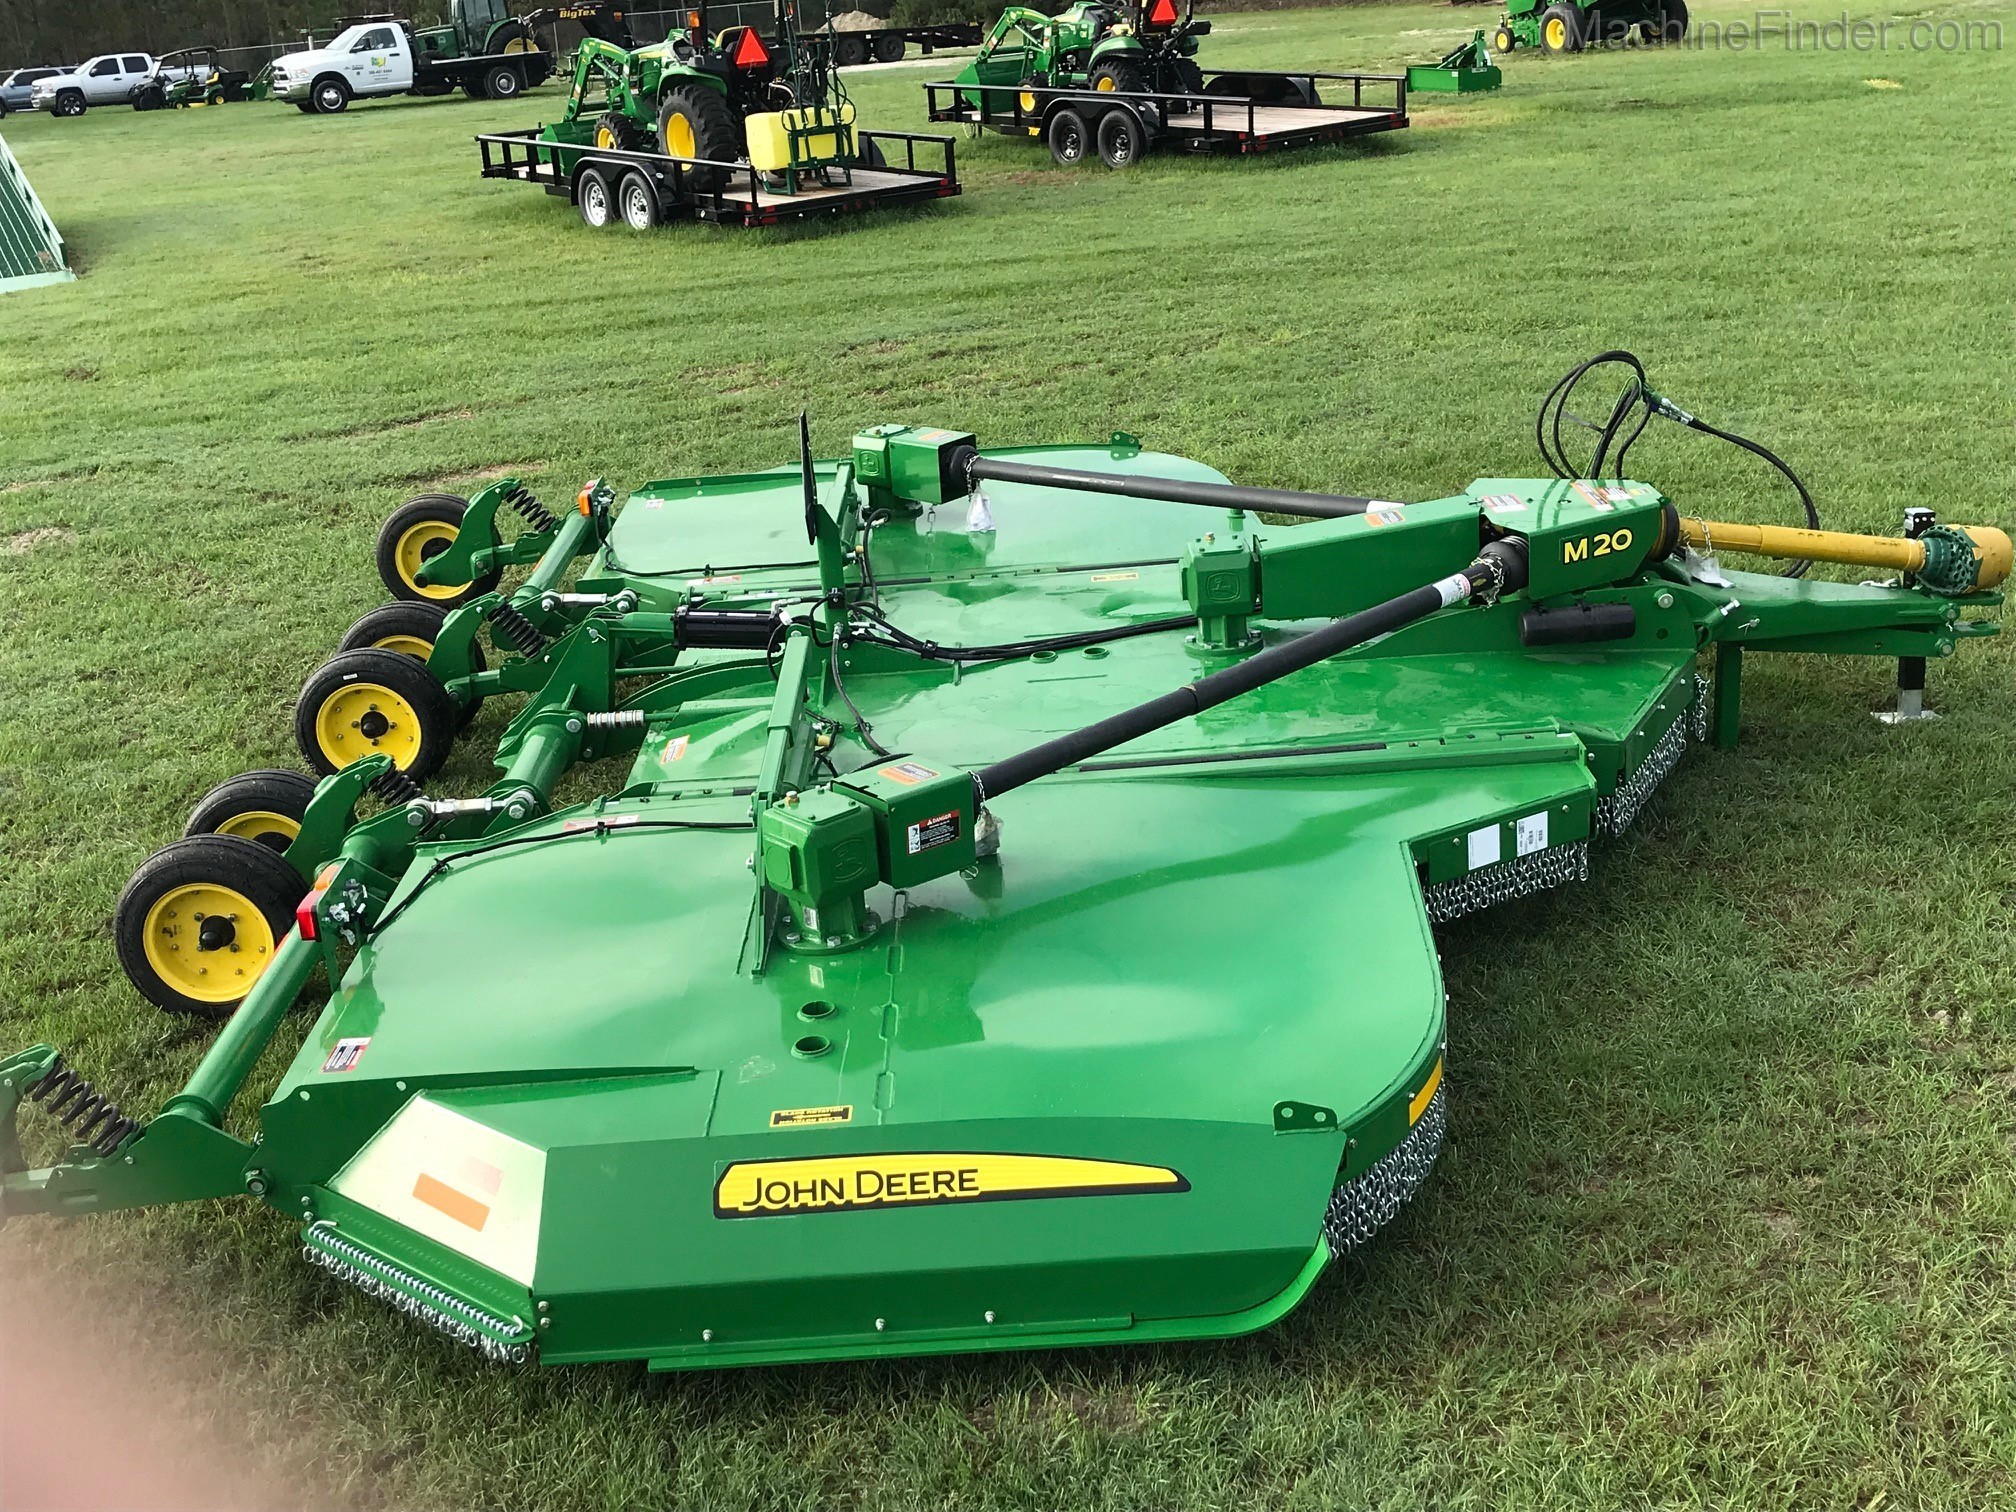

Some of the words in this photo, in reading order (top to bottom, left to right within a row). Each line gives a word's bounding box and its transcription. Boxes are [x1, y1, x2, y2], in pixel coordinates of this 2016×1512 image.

[560, 9, 596, 19] BigTex
[1564, 537, 1588, 564] M
[1593, 528, 1633, 557] 20
[932, 813, 952, 823] DANGER
[743, 1176, 845, 1207] JOHN
[855, 1168, 979, 1199] DEERE
